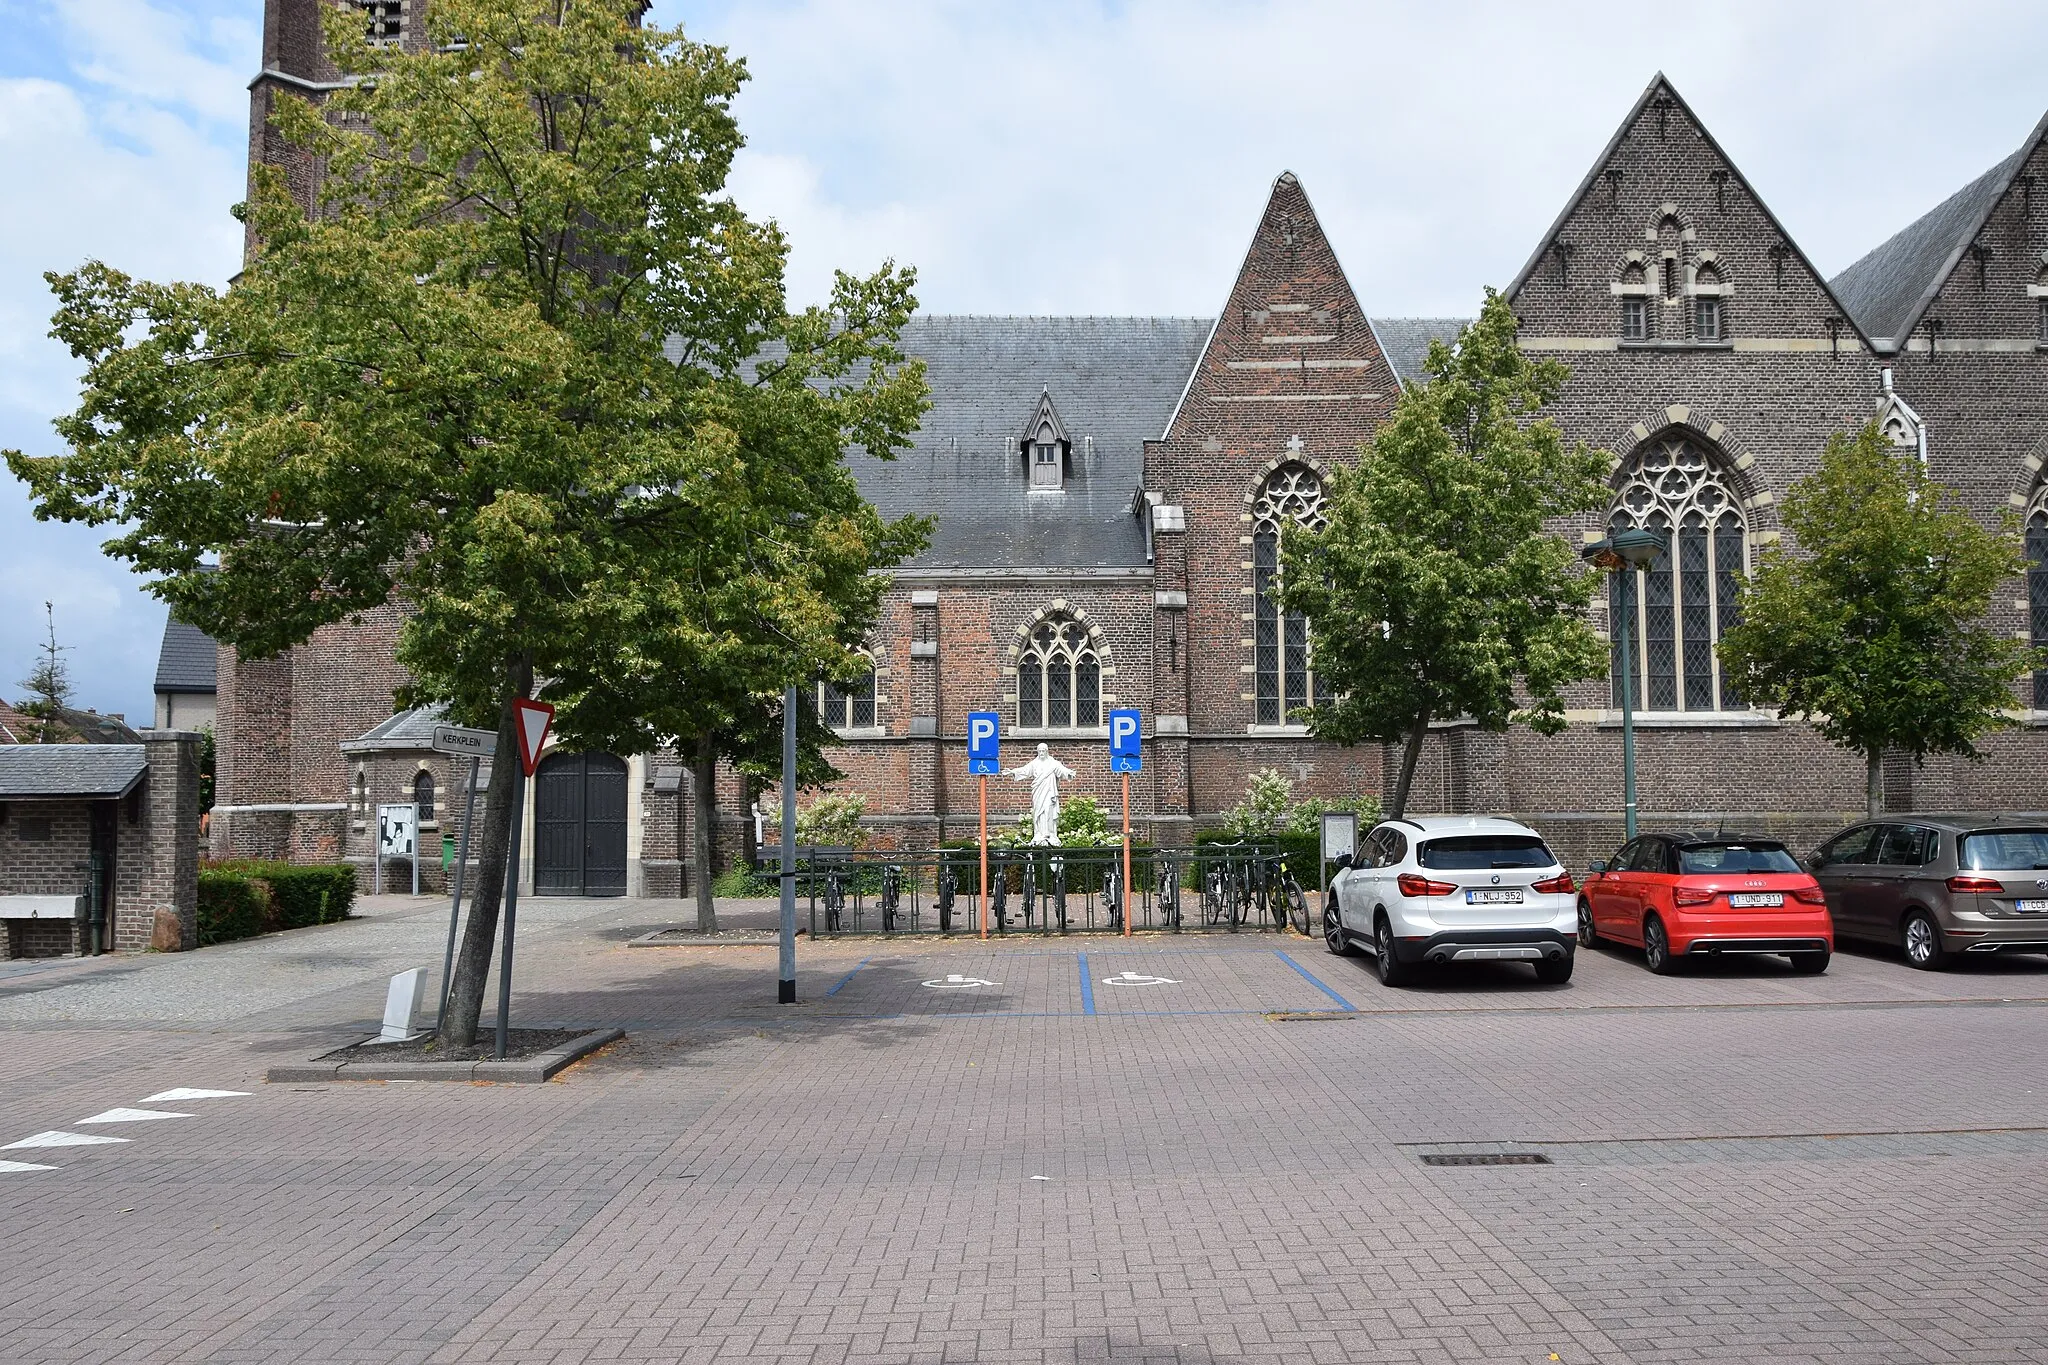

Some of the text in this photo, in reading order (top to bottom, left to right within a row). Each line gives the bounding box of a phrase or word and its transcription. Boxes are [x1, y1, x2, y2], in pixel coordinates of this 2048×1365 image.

[972, 719, 995, 751] P
[1114, 716, 1136, 749] P
[442, 734, 481, 747] KERKPLEIN
[1474, 891, 1521, 902] 1-NLJ-952
[1736, 894, 1781, 904] 1-UND-911
